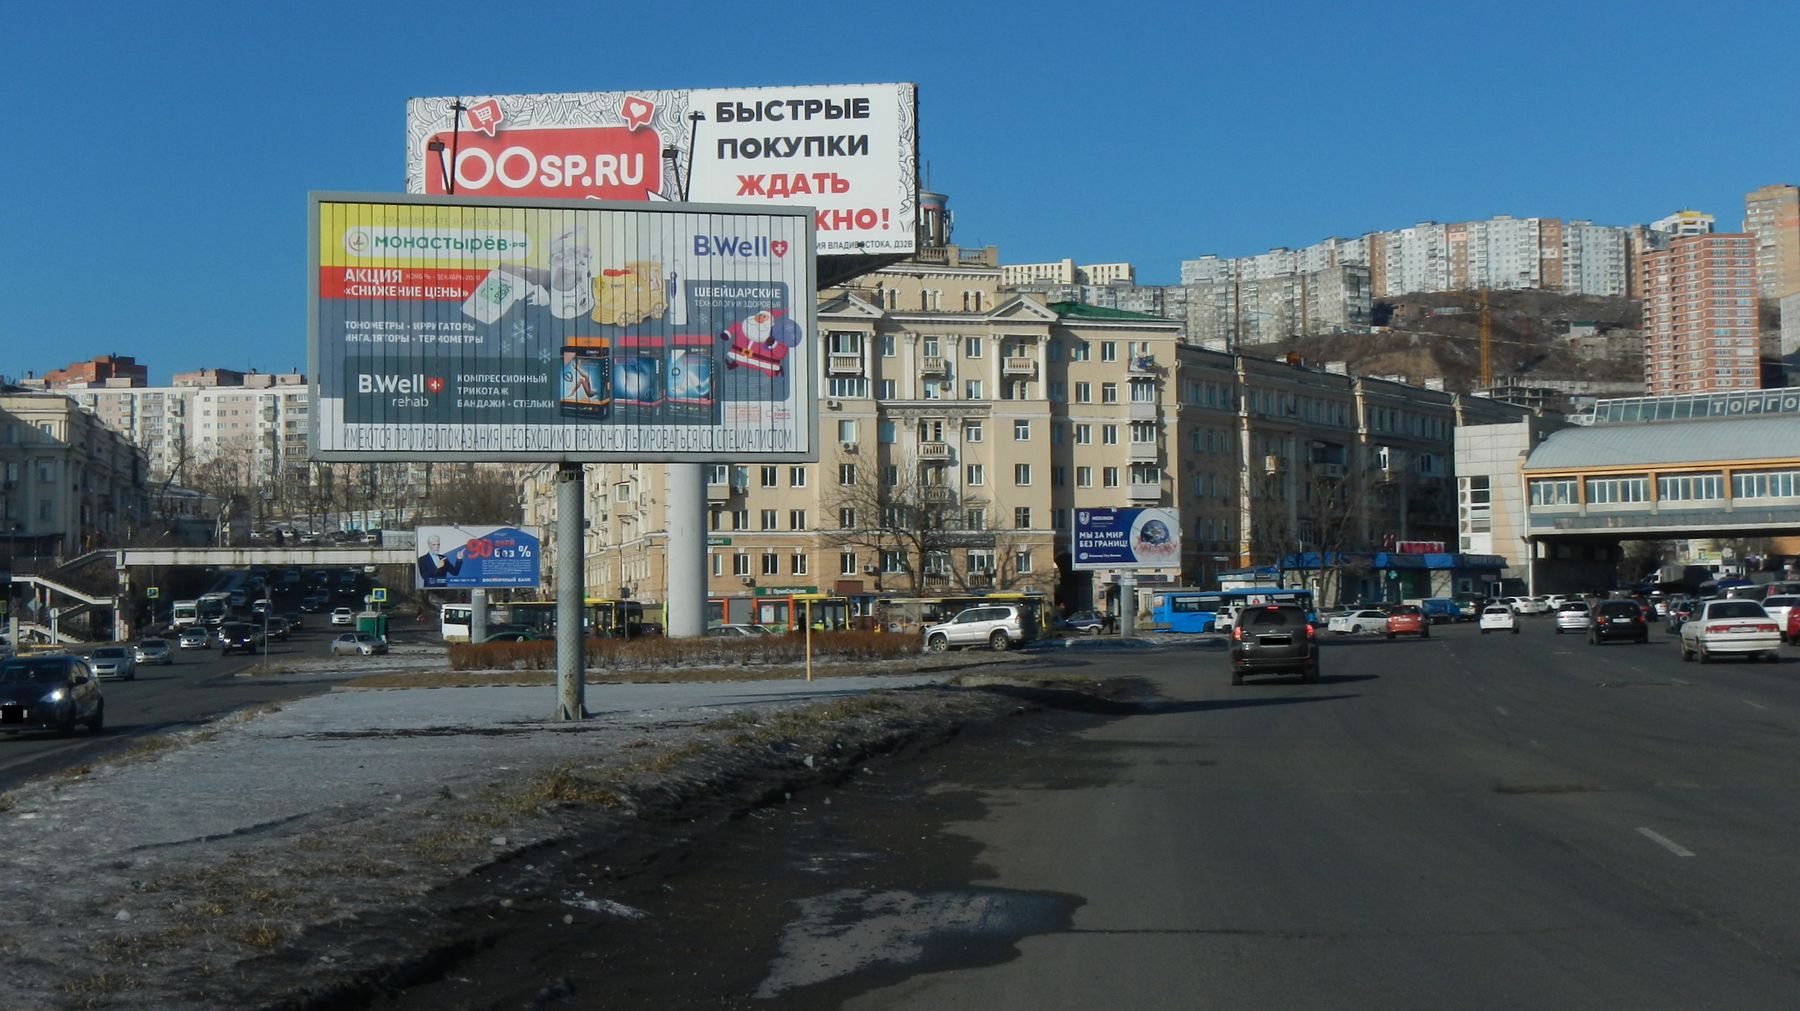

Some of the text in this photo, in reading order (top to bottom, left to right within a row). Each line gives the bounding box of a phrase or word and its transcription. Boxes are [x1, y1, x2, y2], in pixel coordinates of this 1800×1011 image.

[716, 98, 870, 122] БЫСТРЫЕ
[717, 135, 869, 159] ПОКУПКИ
[736, 173, 850, 198] ЖДАТЬ
[694, 235, 767, 257] B.Well
[828, 240, 892, 249] ВЛАДИВСТОКА,
[344, 269, 402, 285] АКЦИЯ
[424, 286, 469, 299] ЦЕНЫ»
[694, 285, 781, 299] ШВЕЙЦАРСКИЕ
[345, 320, 476, 331] ТОНОМЕТРЫ ИРРИГАТОРЫ
[345, 334, 484, 344] ИНГАЛЯТОРЫ ТЕРМОМЕТРЫ
[358, 374, 424, 393] B.Well
[457, 373, 548, 383] КОМПРЕССИОННЫЙ
[457, 386, 509, 396] ТРИКОТАЖ
[392, 396, 429, 407] rehab
[457, 399, 555, 409] БАНДАЖИ СТЕЛЬКИ
[344, 428, 391, 449] ИМЕЮТСЯ
[505, 428, 571, 449] НЕОБХОДИМО
[576, 428, 698, 449] ПРОКОНСУЛЬТИРОВАТЬСЯ
[701, 428, 713, 449] СО
[717, 428, 792, 449] СПЕЦИАЛИСТОМ
[1079, 531, 1124, 539] МЫ ЗА МИР
[466, 538, 493, 558] 90
[1079, 540, 1128, 548] БЕЗ ГРАНИЦ!
